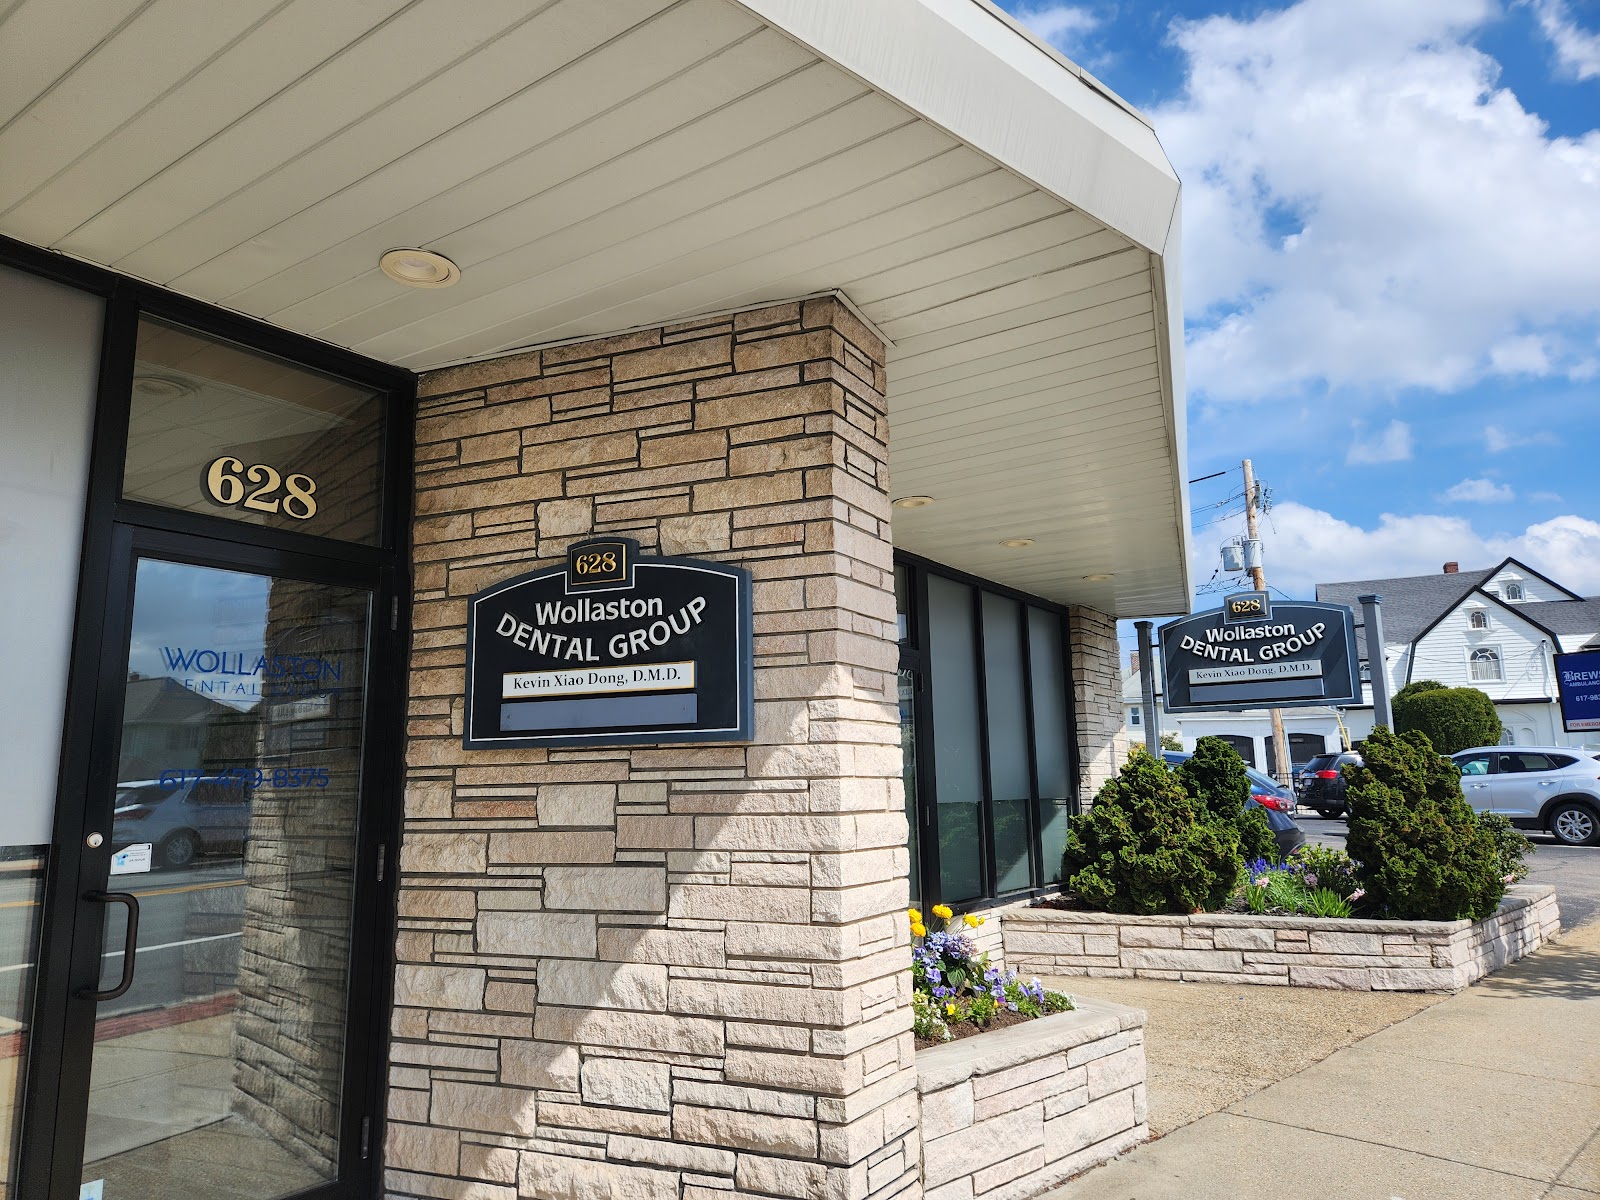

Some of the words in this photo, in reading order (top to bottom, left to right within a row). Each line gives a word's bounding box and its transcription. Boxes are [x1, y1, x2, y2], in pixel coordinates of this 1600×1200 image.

[206, 456, 318, 520] 628
[575, 552, 617, 575] 628
[535, 597, 663, 626] Wollaston
[1231, 599, 1261, 613] 628
[495, 612, 600, 662] DENTAL
[608, 596, 708, 659] GROUP
[1205, 623, 1295, 643] Wollaston
[1180, 634, 1255, 663] DENTAL
[1258, 622, 1326, 661] GROUP
[164, 646, 341, 681] WOLLASTON
[1196, 670, 1222, 679] Kevin
[1224, 668, 1246, 677] Xiao
[1248, 666, 1277, 676] Dong,
[1279, 663, 1313, 673] D.M.D.
[166, 679, 260, 696] DENTAL
[513, 676, 550, 690] Kevin
[553, 673, 584, 687] Xiao
[588, 671, 629, 687] Dong,
[632, 668, 681, 682] D.M.D.
[159, 767, 329, 790] 617-479-8375
